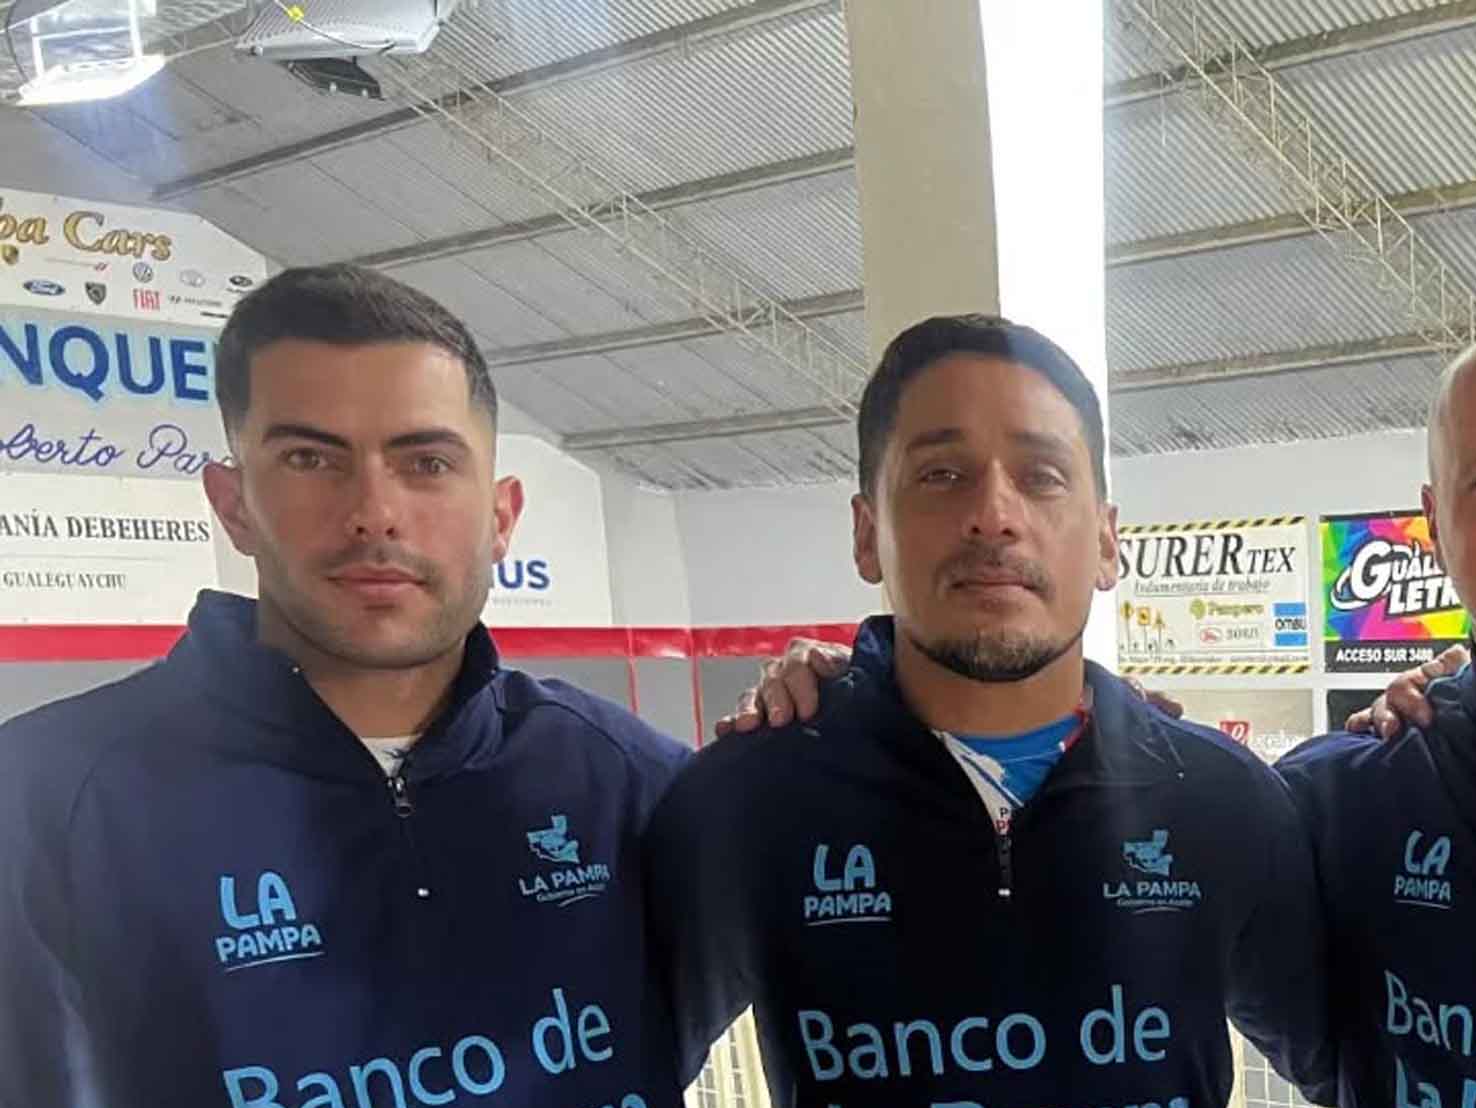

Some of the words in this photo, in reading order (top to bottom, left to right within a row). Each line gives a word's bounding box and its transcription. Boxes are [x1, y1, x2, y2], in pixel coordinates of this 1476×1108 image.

[63, 210, 173, 261] Cars
[0, 423, 125, 466] berto
[65, 515, 210, 542] DEBEHERES
[1336, 648, 1382, 662] ACCESO
[1384, 648, 1407, 662] SUR
[813, 844, 876, 891] LA
[1404, 829, 1451, 876] LA
[519, 876, 549, 895] LA
[551, 864, 610, 888] PAMPA
[1103, 881, 1132, 898] LA
[1136, 880, 1201, 898] PAMPA
[1394, 875, 1451, 901] PAMPA
[220, 872, 297, 929] LA
[804, 892, 891, 919] PAMPA
[216, 923, 321, 962] PAMPA
[532, 988, 614, 1074] de
[798, 1009, 1046, 1081] Banco
[1080, 984, 1170, 1064] de
